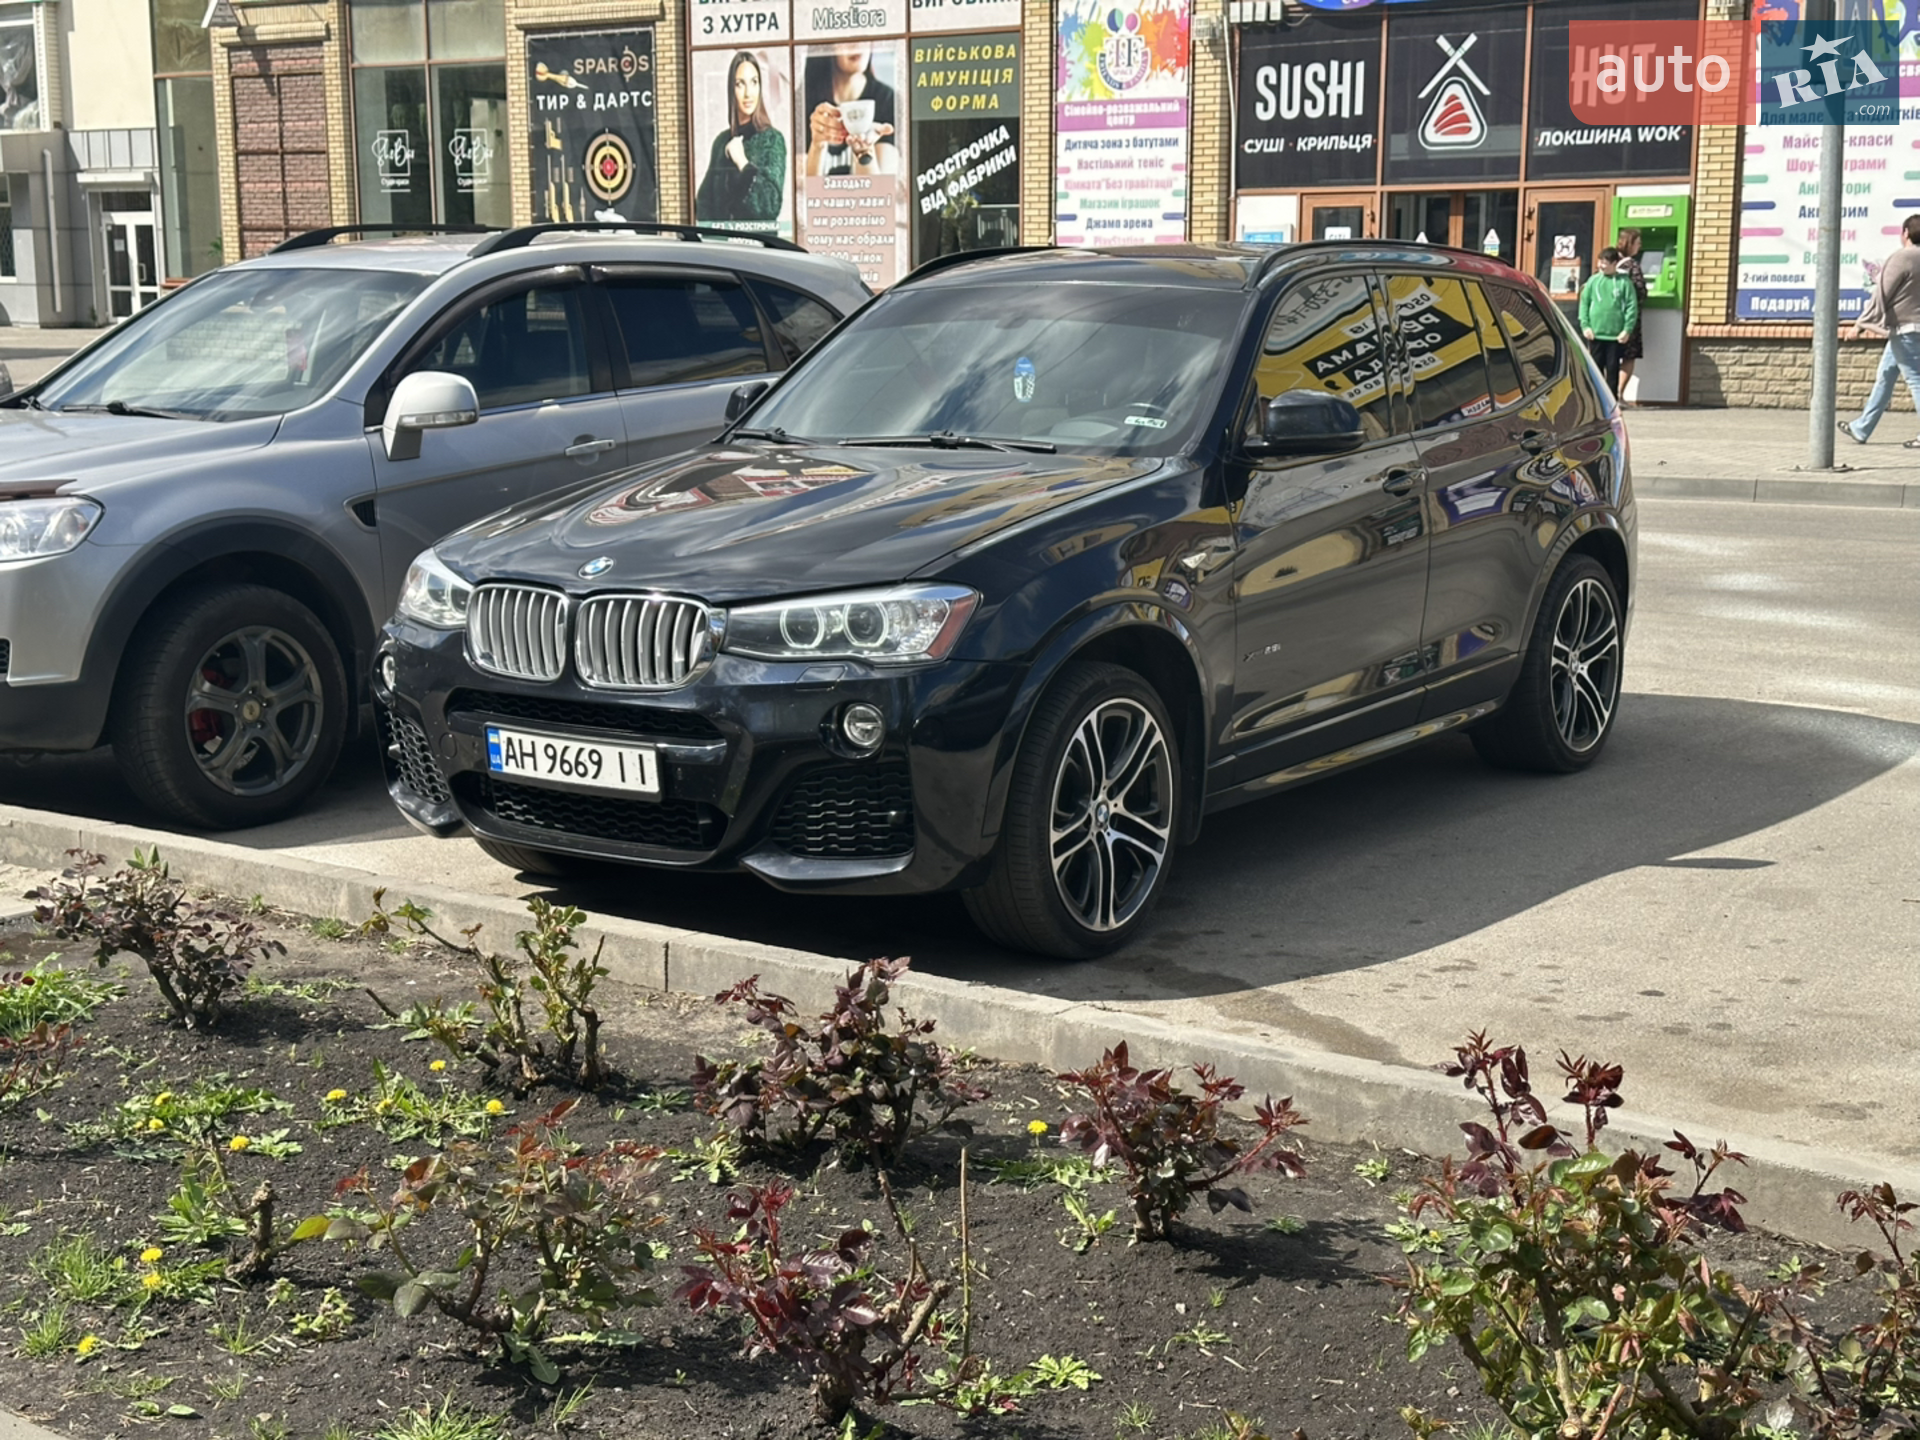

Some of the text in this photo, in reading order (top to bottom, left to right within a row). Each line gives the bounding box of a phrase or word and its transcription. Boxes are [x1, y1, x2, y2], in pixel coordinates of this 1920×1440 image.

[720, 12, 780, 34] ХУТРА
[914, 43, 1017, 64] ВІЙСЬКОВА
[916, 67, 1014, 88] АМУНІЦІЯ
[536, 90, 653, 111] ТИР & ДАРТС
[1255, 59, 1365, 122] SUSHI
[930, 93, 999, 112] ФОРМА
[1064, 138, 1099, 152] Дитяча
[1100, 139, 1123, 150] зона
[1132, 135, 1180, 150] батутами
[1244, 134, 1373, 153] СУШІ КРИЛЬЦЯ
[1537, 126, 1683, 147] ЛОКШИНА WOK
[1782, 134, 1894, 149] Майс-класи
[916, 124, 1011, 192] РОЗСТРОЧКА
[1077, 155, 1165, 171] Настільний теніс
[823, 177, 872, 190] Заходьте
[920, 144, 1017, 215] ВІД ФАБРИКИ
[1085, 217, 1154, 231] Джамп арена
[1750, 296, 1811, 313] Подаруй
[505, 736, 538, 772] AH
[544, 743, 602, 779] 9669
